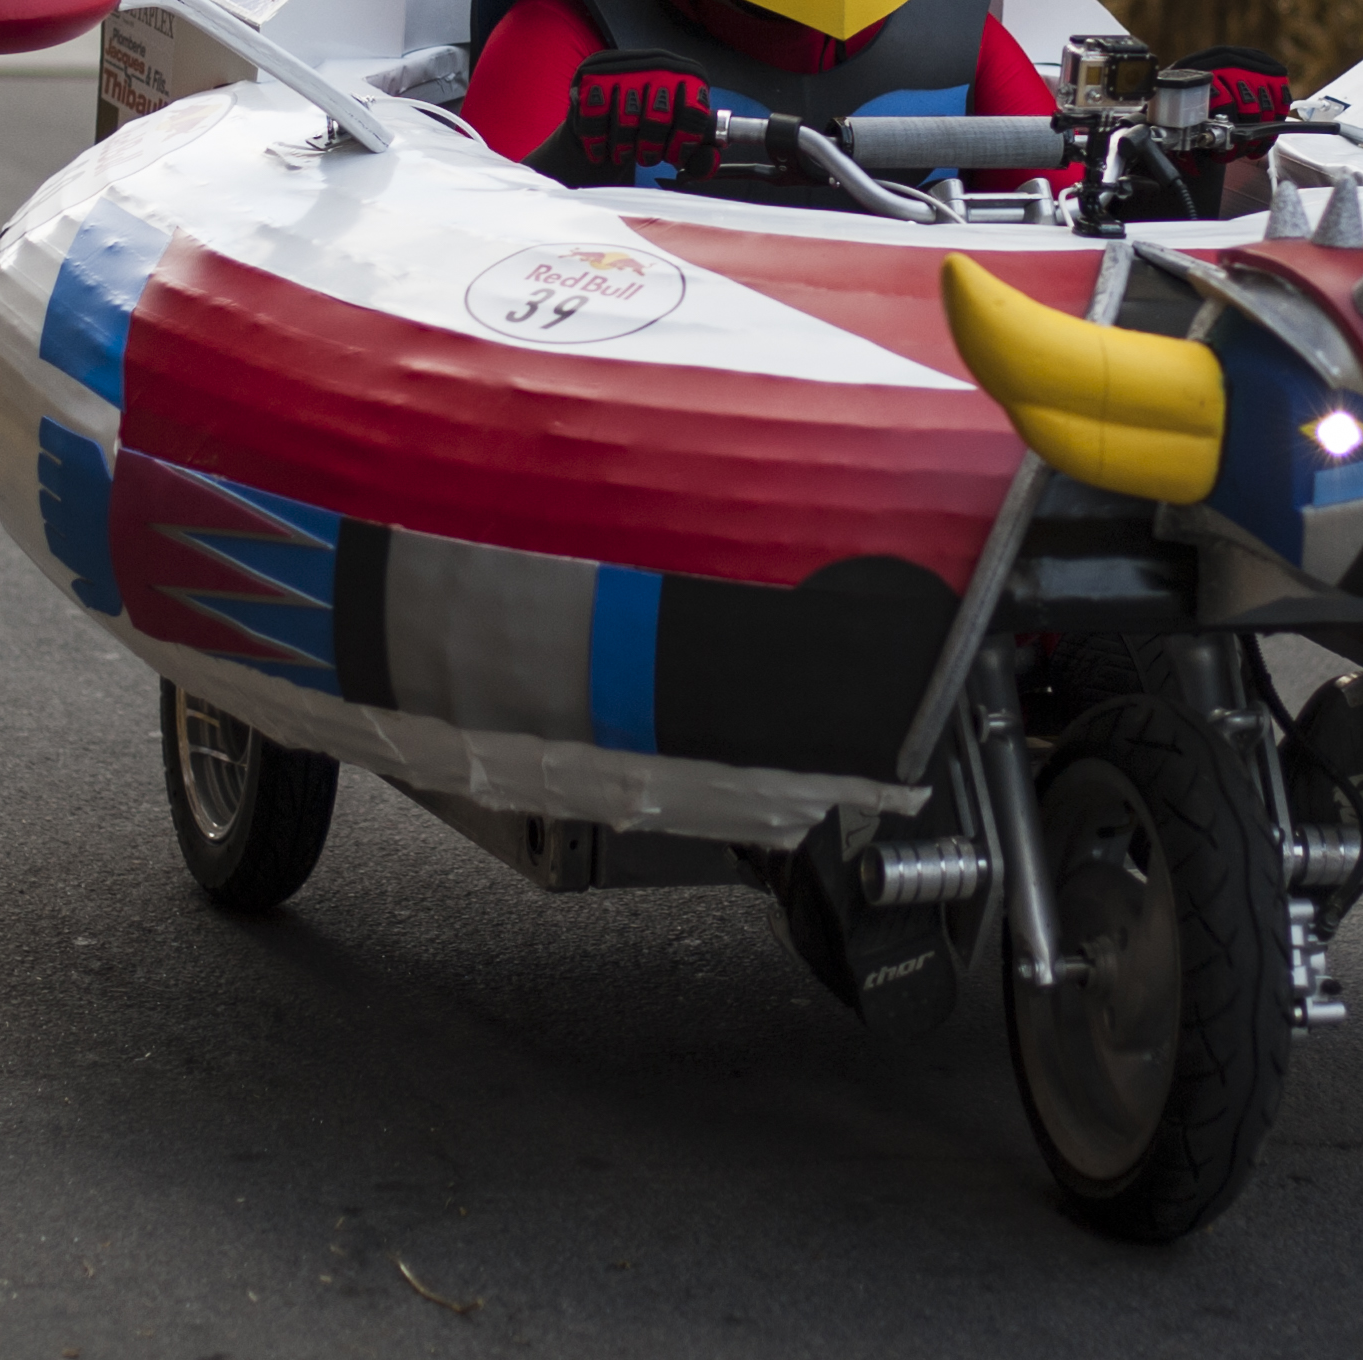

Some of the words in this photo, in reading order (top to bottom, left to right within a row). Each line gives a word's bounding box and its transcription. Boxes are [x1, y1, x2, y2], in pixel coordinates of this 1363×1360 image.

[105, 36, 146, 76] Jacques
[524, 263, 590, 290] Red
[581, 274, 645, 302] Bull
[504, 287, 590, 330] 39
[863, 950, 935, 991] thor
